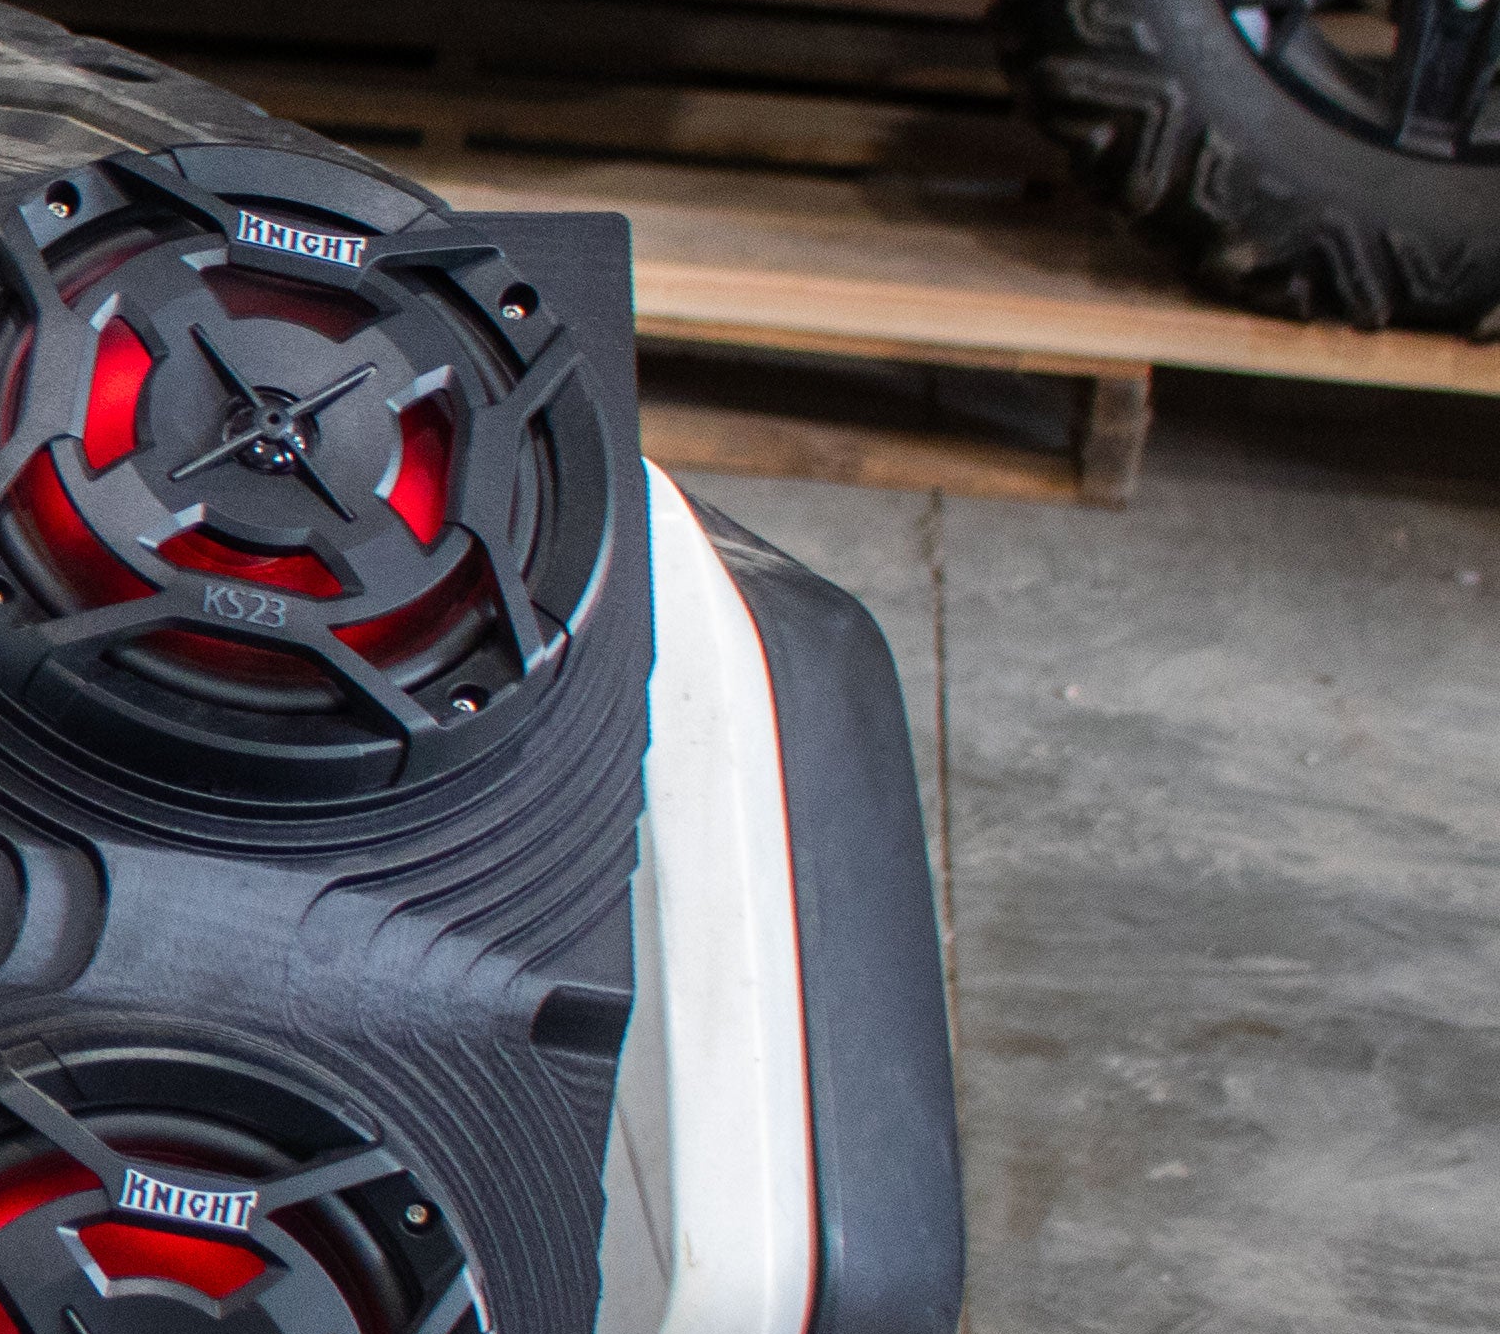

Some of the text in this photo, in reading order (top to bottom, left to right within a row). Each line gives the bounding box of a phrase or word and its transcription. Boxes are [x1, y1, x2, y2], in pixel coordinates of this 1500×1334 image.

[238, 210, 367, 267] KNIGHT
[202, 585, 286, 628] KS23
[119, 1169, 260, 1232] KNIGHT
